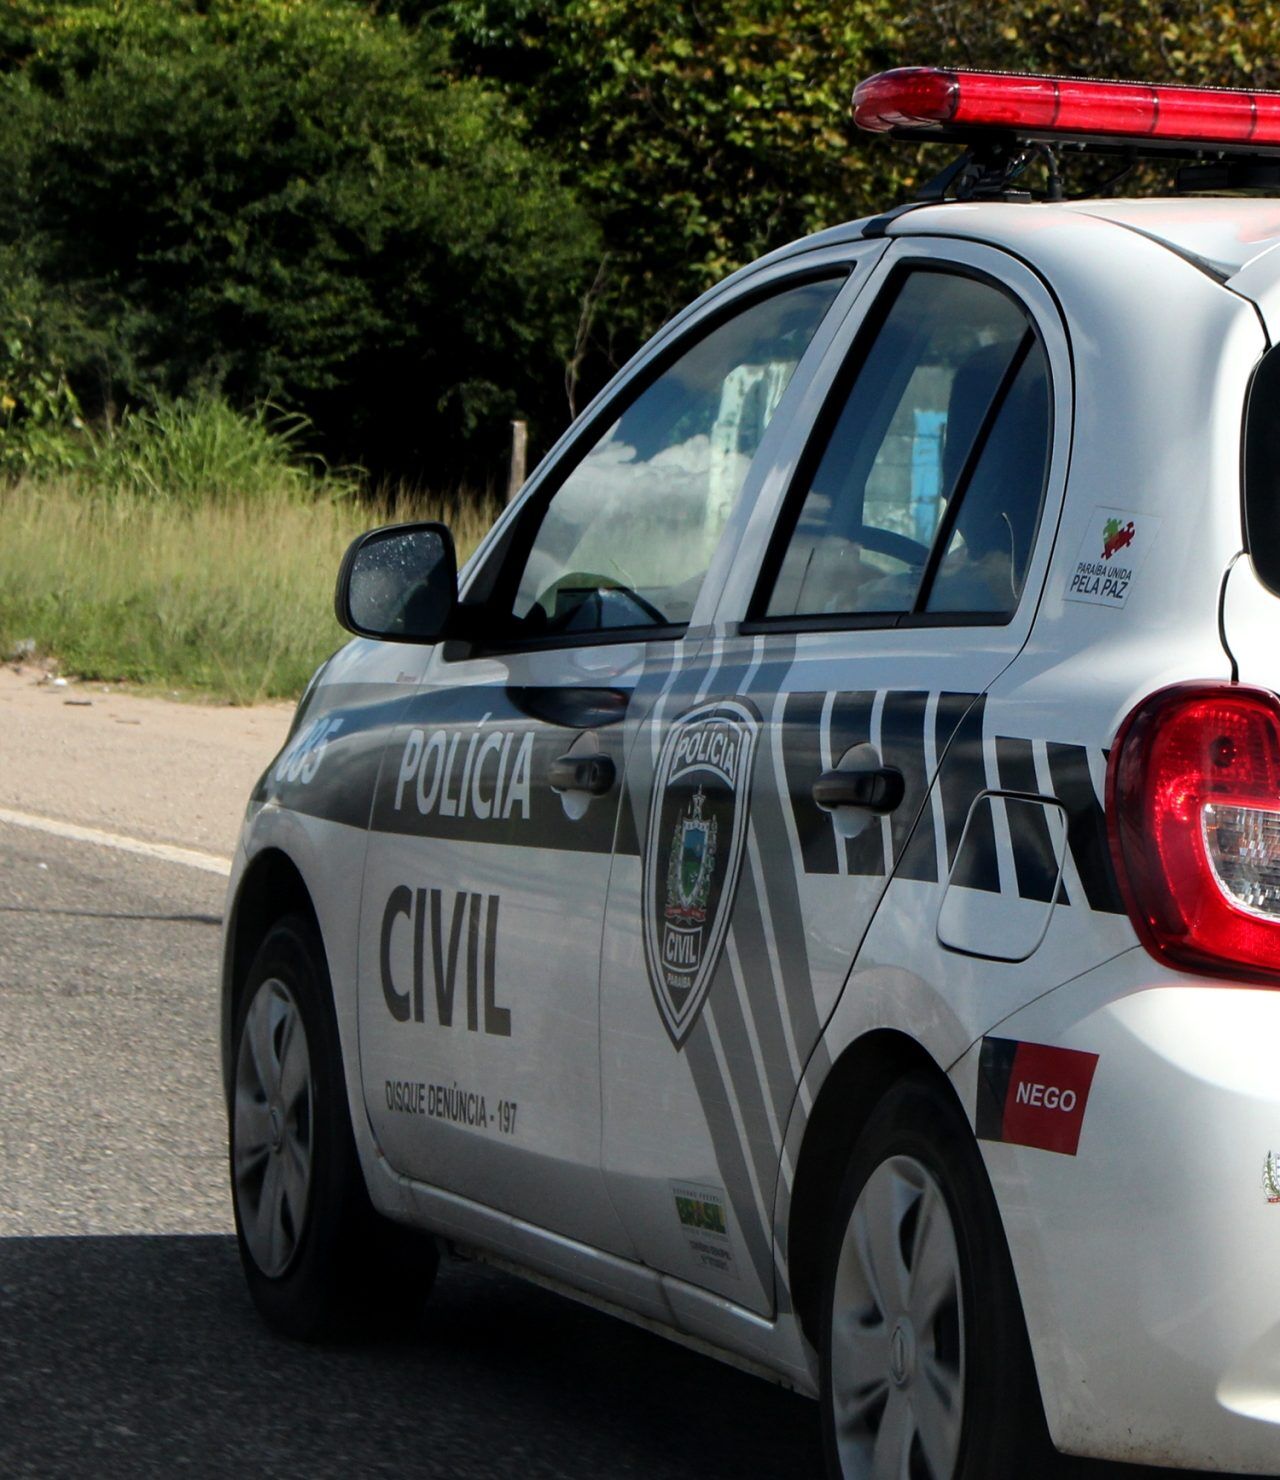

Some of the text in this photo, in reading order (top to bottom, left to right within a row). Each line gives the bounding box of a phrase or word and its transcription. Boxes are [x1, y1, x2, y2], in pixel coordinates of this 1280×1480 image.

[1070, 575, 1129, 599] PELA PAZ
[1076, 561, 1132, 581] PARAÍBA UNIDA
[393, 712, 535, 820] POLÍCIA
[379, 884, 513, 1037] CIVIL
[665, 931, 697, 964] CIVIL
[384, 1080, 426, 1115] DISQUE
[427, 1081, 488, 1128] DENÚNCIA
[497, 1100, 517, 1134] 197
[1015, 1081, 1077, 1113] NEGO
